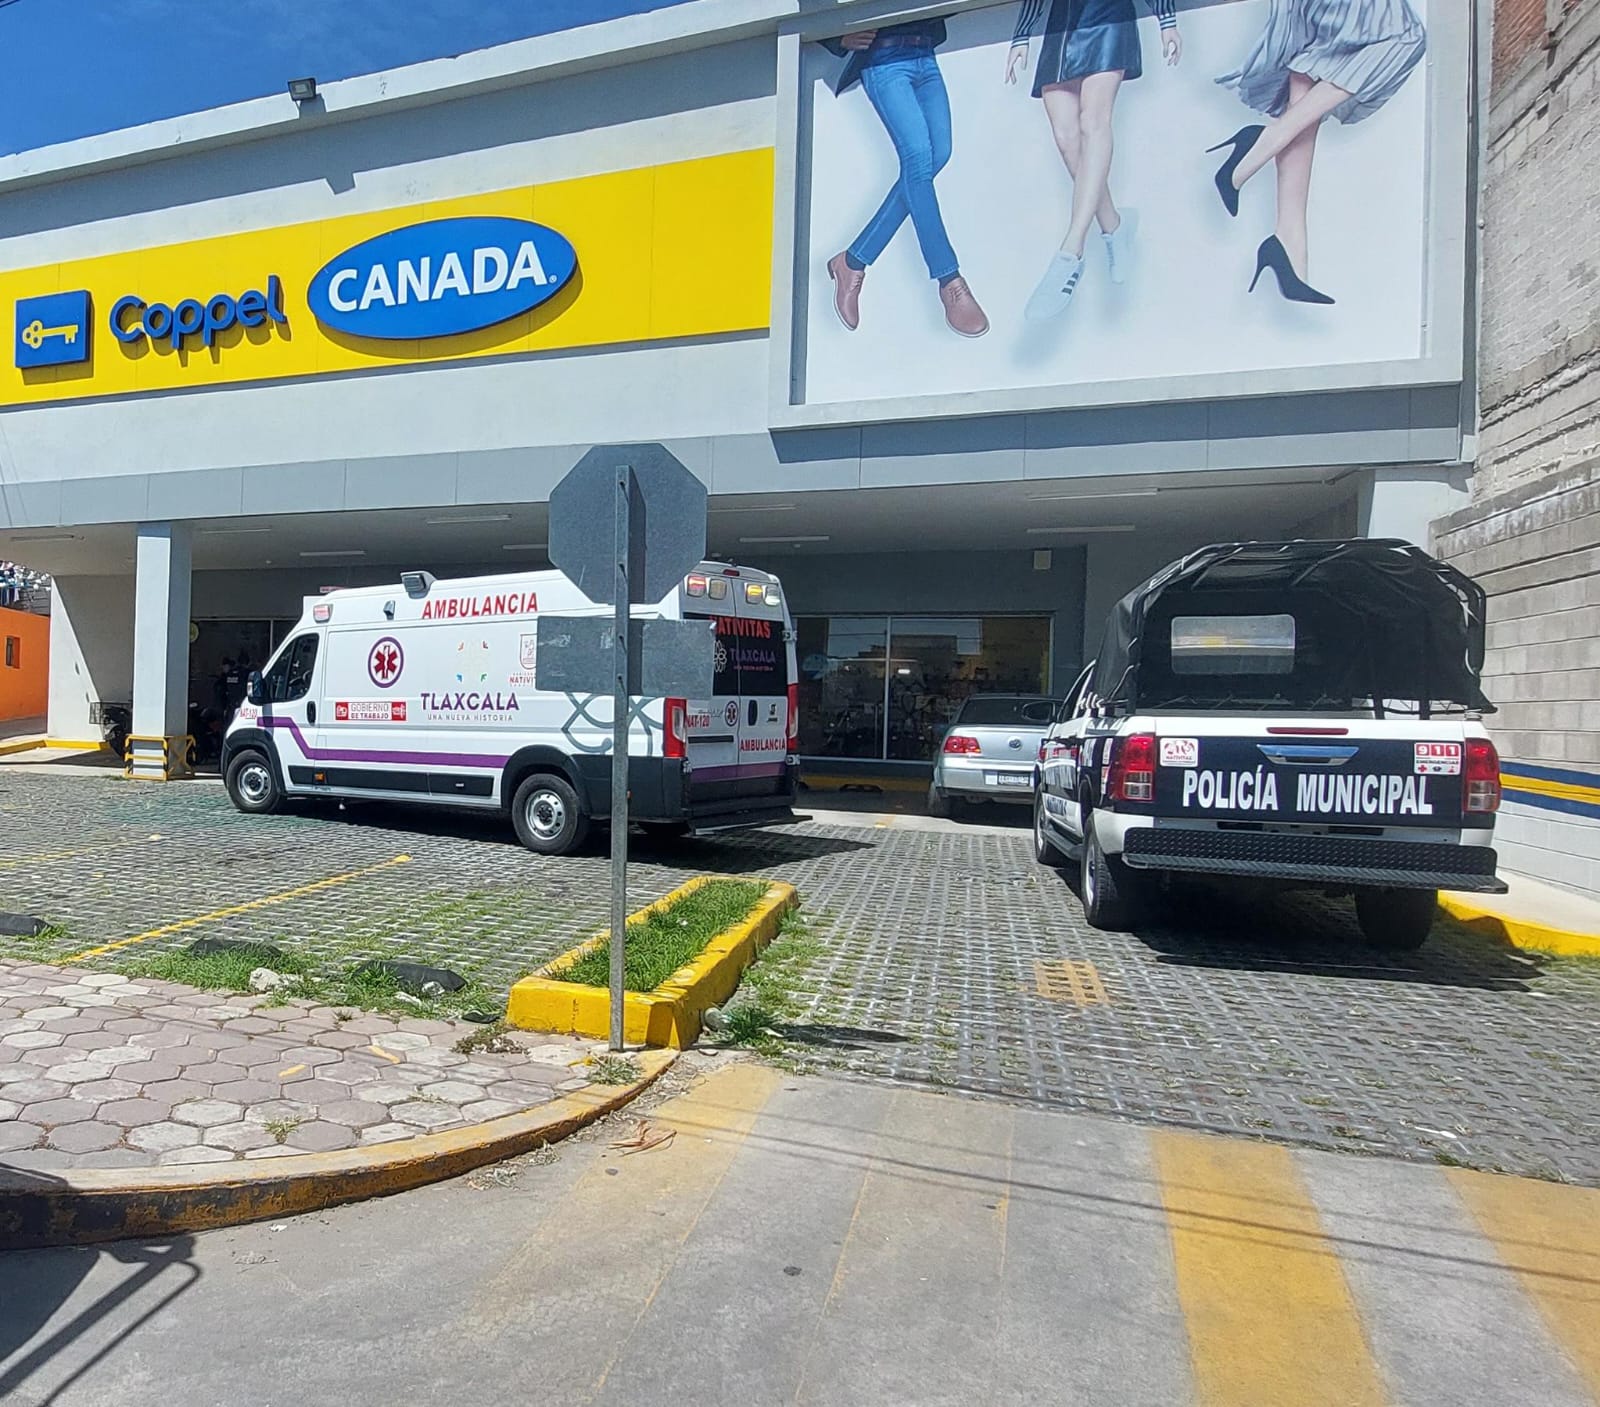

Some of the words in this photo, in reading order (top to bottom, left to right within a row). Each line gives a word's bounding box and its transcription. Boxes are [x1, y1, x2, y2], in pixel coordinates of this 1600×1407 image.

[110, 274, 287, 349] Coppel
[422, 592, 538, 619] AMBULANCIA
[730, 648, 776, 663] TLAXCALA
[351, 703, 389, 711] GOBIERNO
[421, 692, 519, 710] TLAXCALA
[687, 714, 710, 727] NAT-120
[740, 738, 785, 751] AMBULANCIA
[1418, 745, 1457, 755] 911
[1183, 764, 1279, 811] POLICÍA
[1296, 773, 1433, 815] MUNICIPAL
